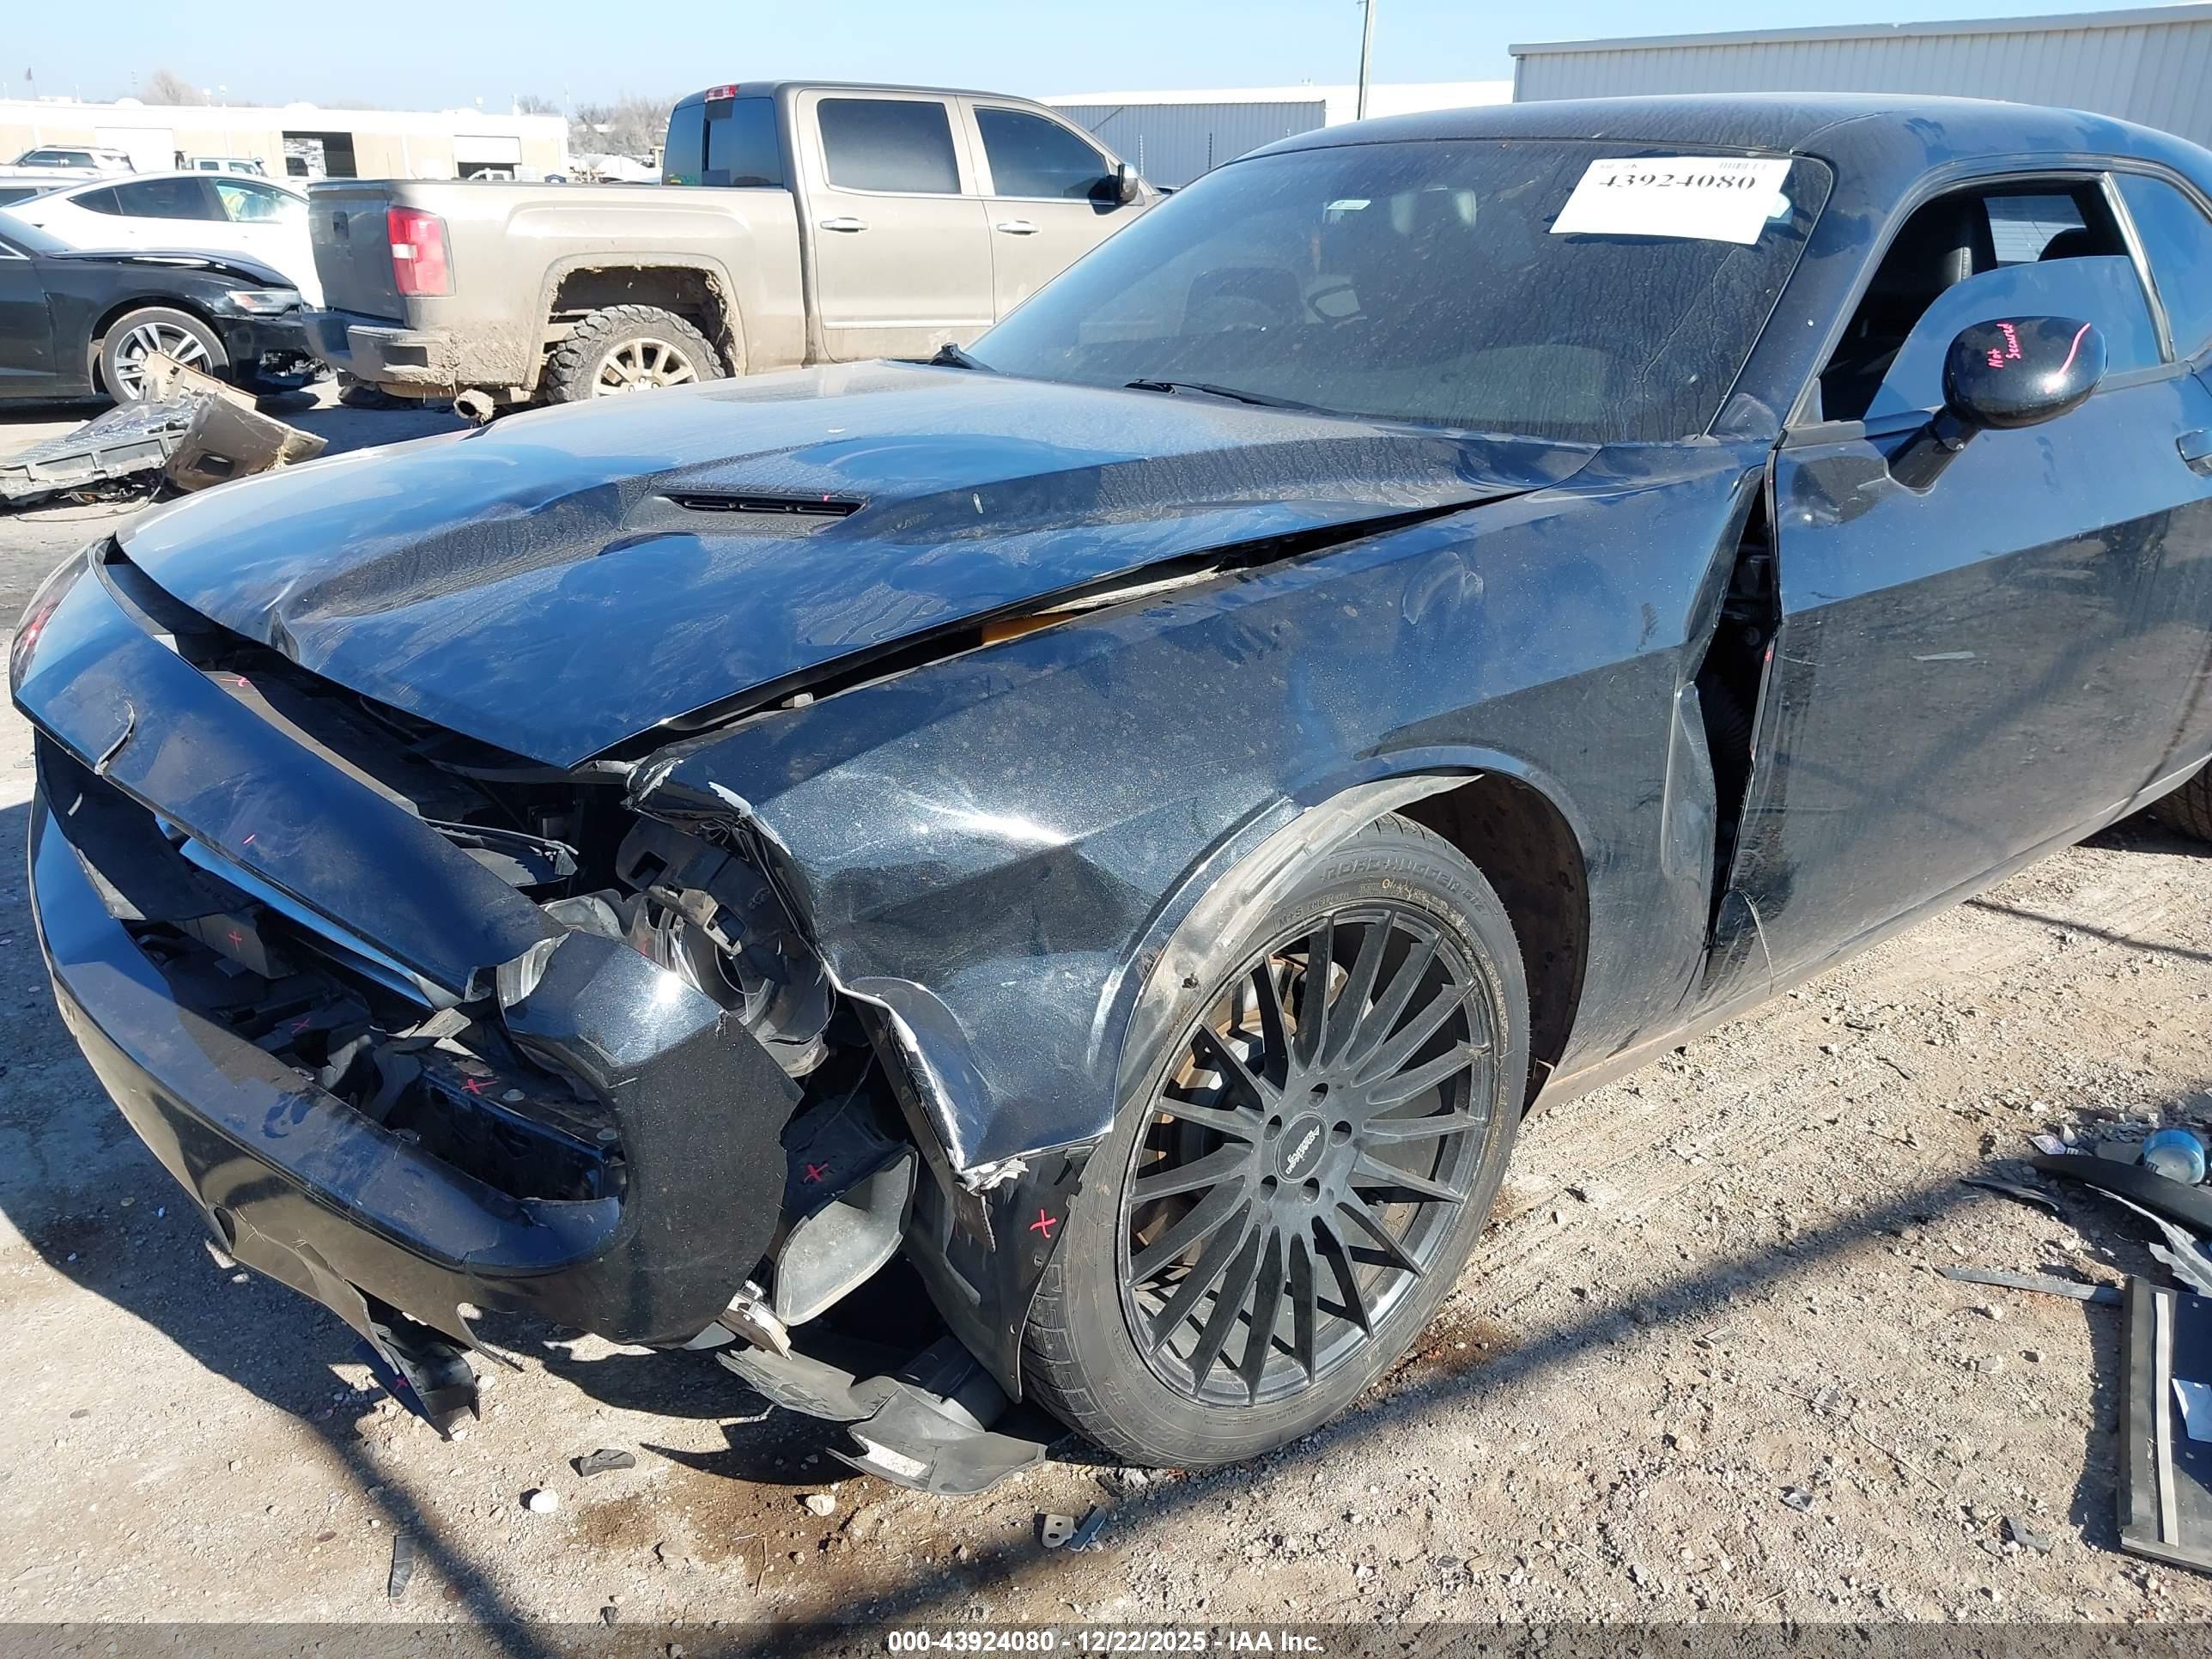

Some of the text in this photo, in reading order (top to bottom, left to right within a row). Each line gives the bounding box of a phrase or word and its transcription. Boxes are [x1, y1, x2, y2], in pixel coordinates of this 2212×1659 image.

[1599, 173, 1756, 190] 43924080
[1996, 323, 2021, 359] Secured
[1986, 348, 2004, 368] Not
